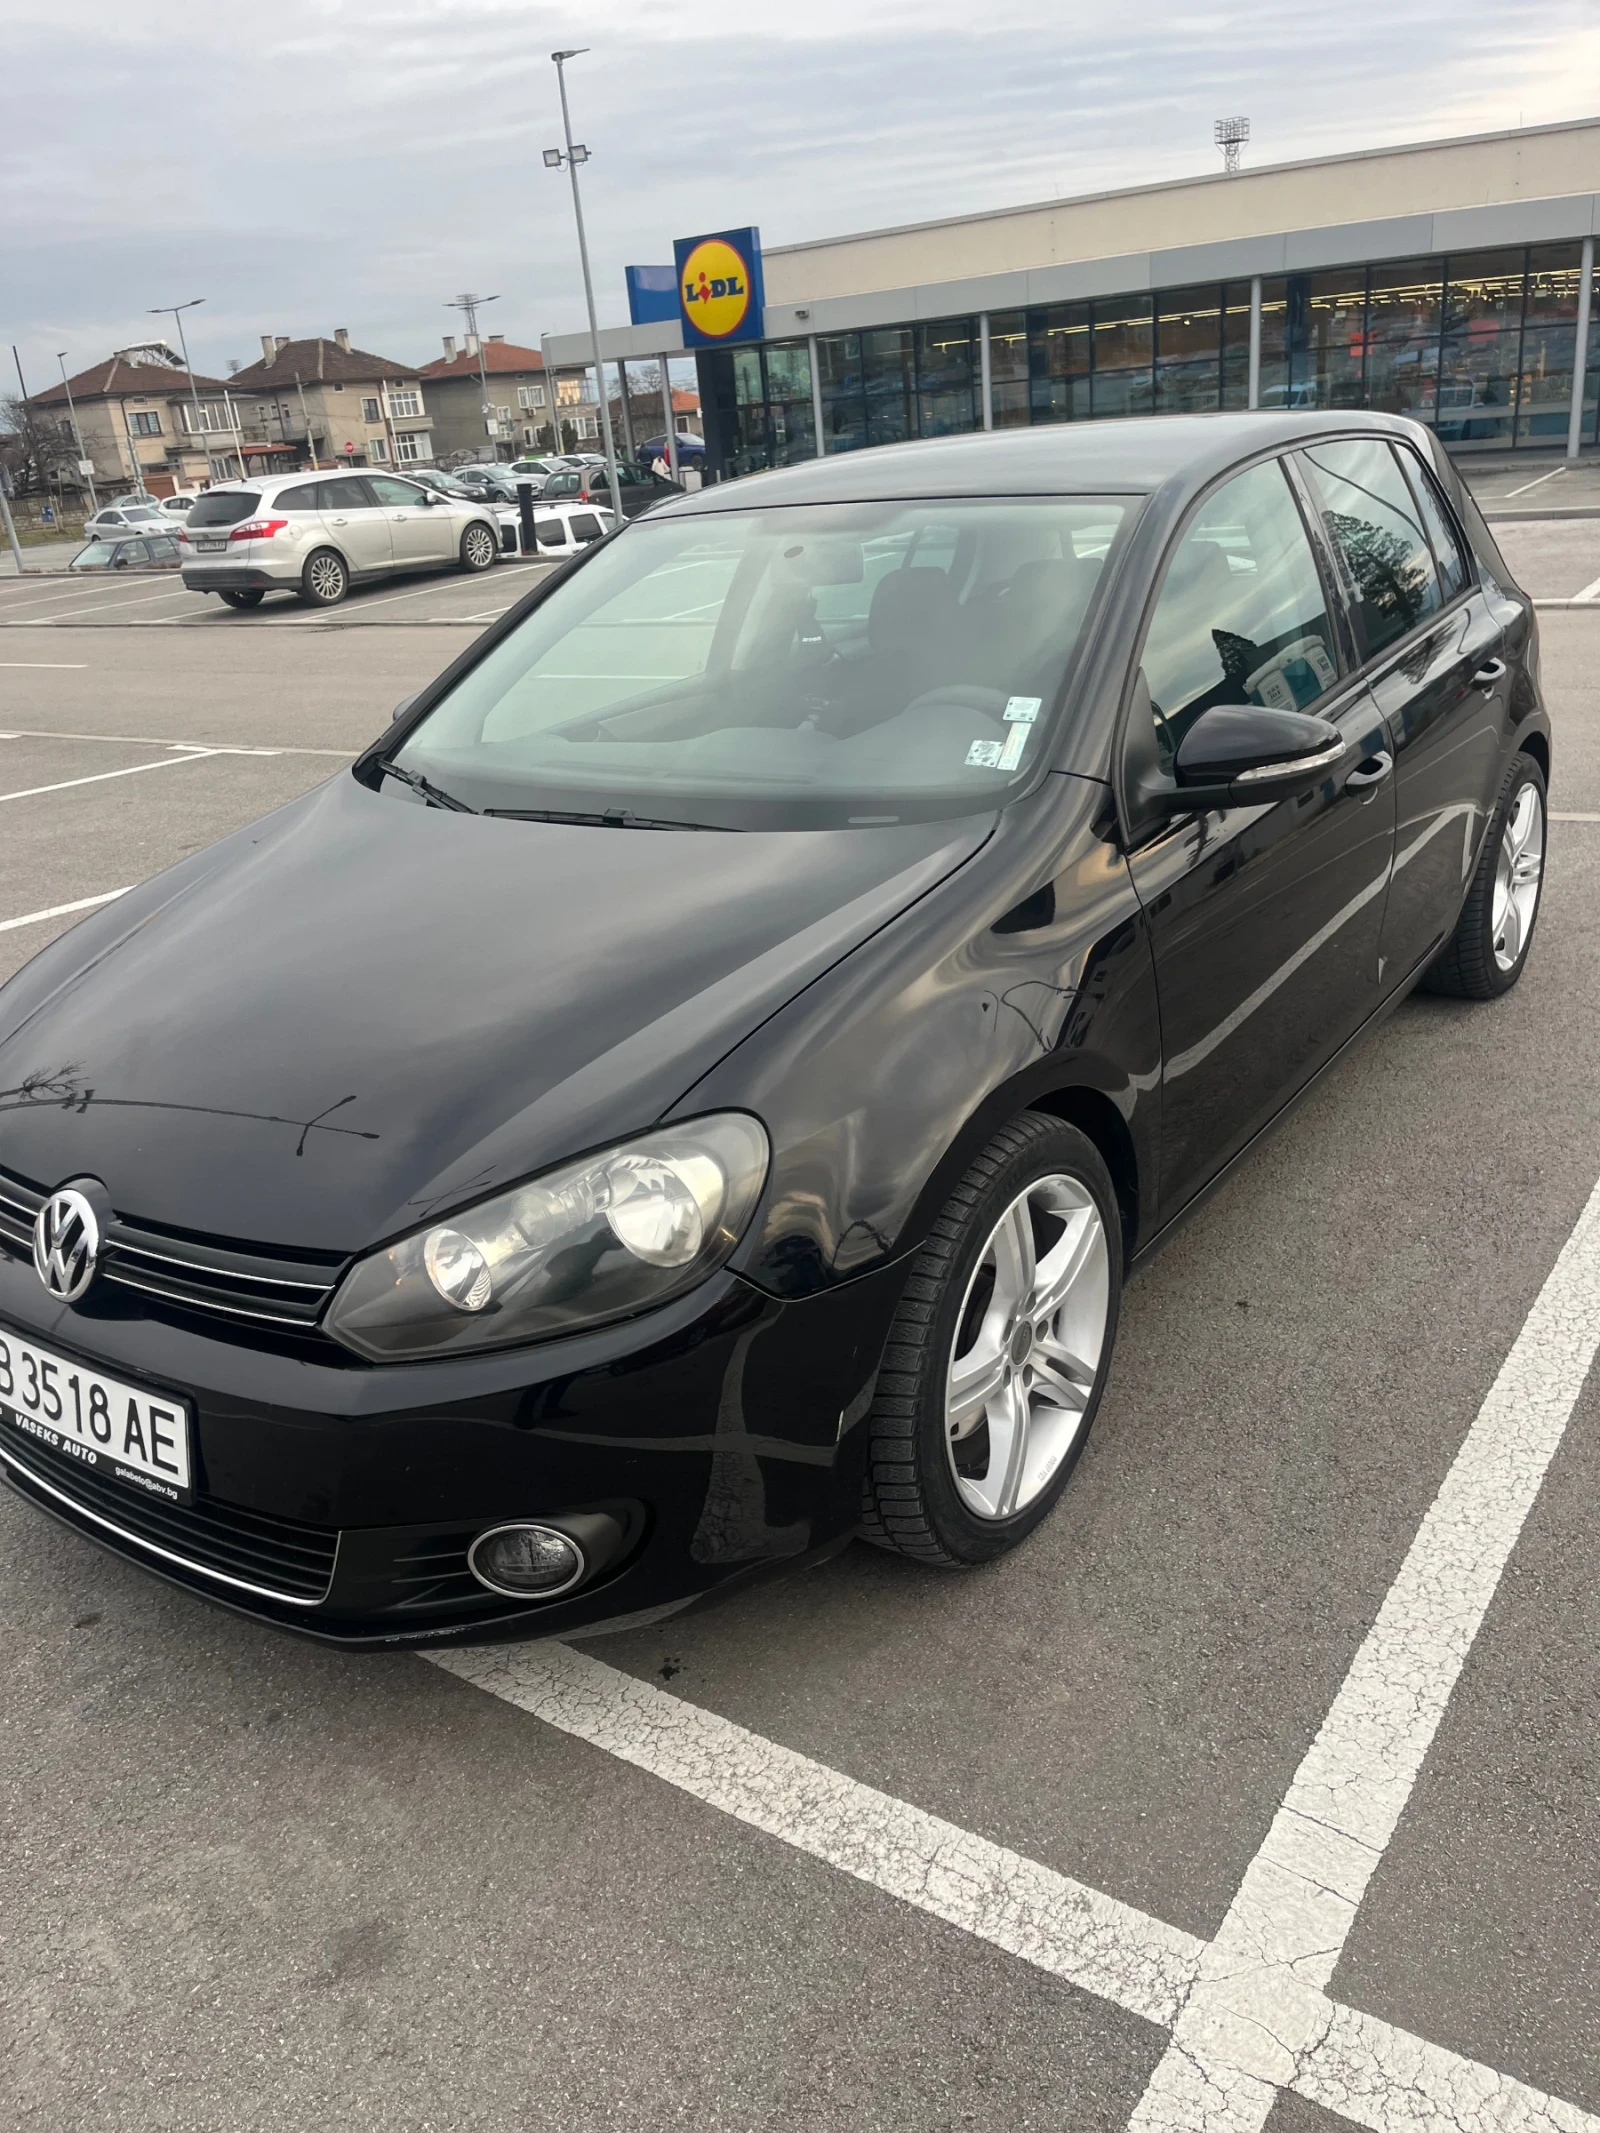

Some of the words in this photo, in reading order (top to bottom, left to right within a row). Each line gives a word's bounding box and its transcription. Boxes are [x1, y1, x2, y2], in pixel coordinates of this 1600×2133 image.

[15, 1413, 59, 1446] VASEKS
[62, 1440, 98, 1465] AUTO
[22, 1351, 112, 1444] 3518
[123, 1397, 179, 1475] AE
